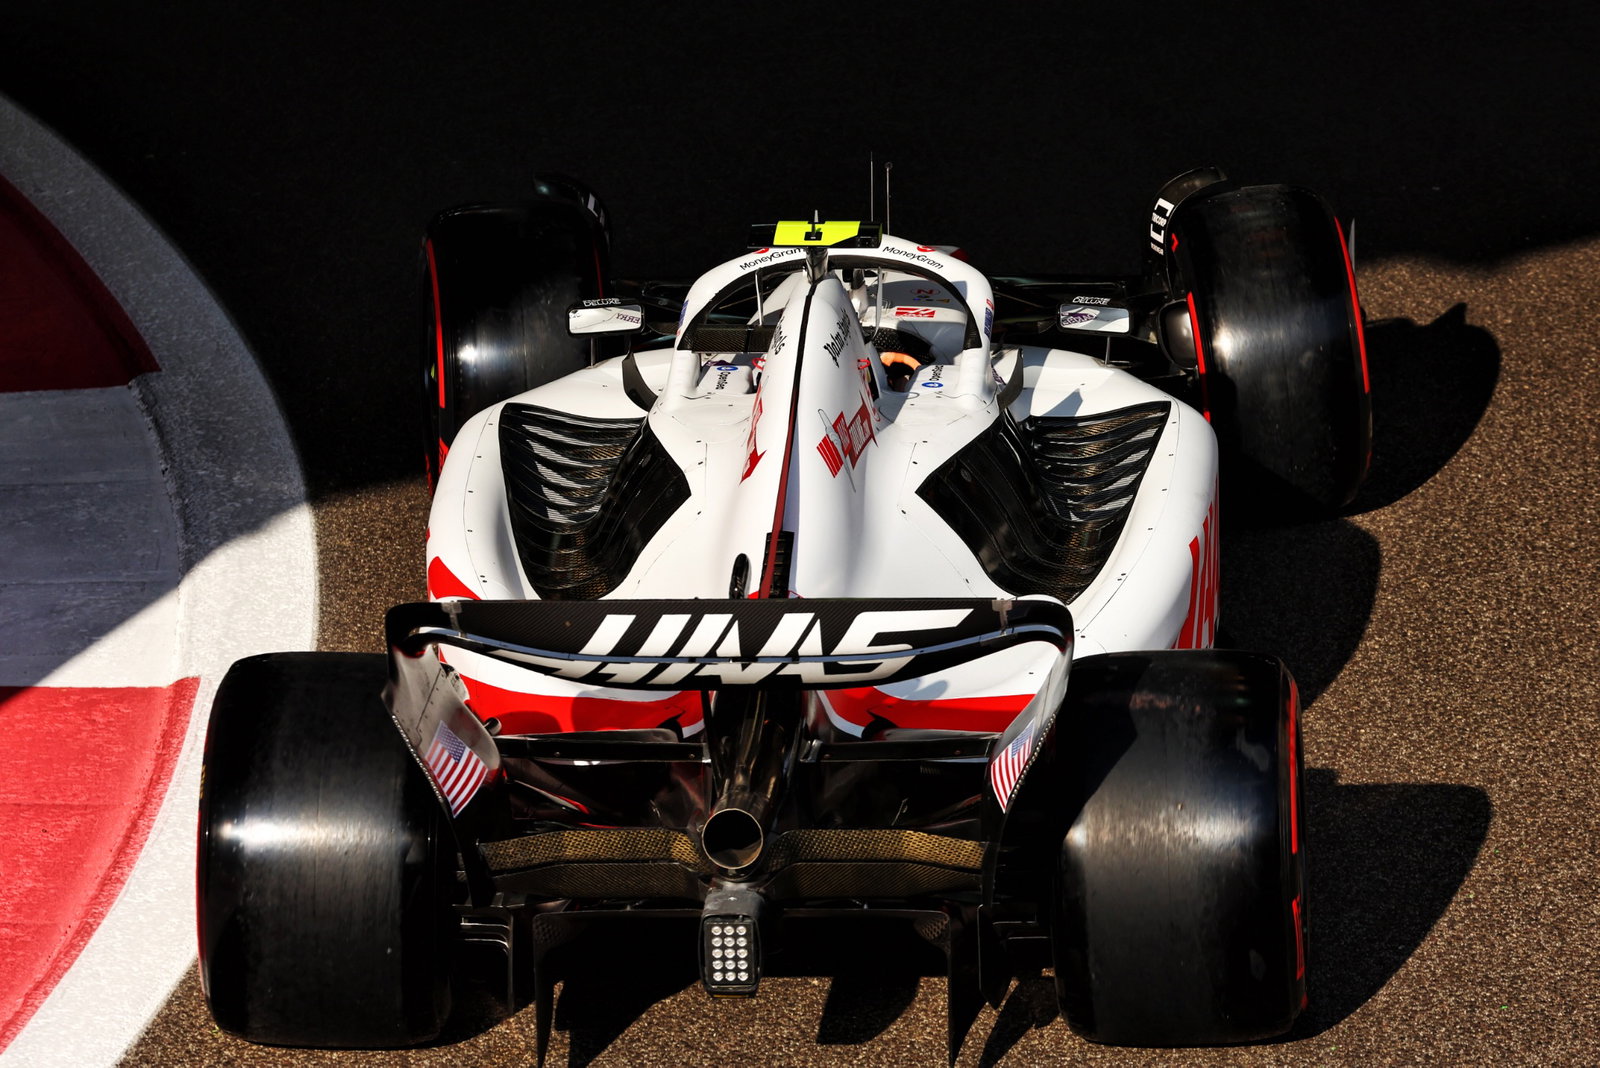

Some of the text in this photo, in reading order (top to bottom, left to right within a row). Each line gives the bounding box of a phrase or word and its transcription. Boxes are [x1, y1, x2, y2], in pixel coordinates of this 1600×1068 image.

[882, 245, 944, 270] MoneyGram
[582, 297, 622, 307] DELUXE
[1071, 296, 1113, 306] DELUXE
[494, 607, 974, 686] HAAS
